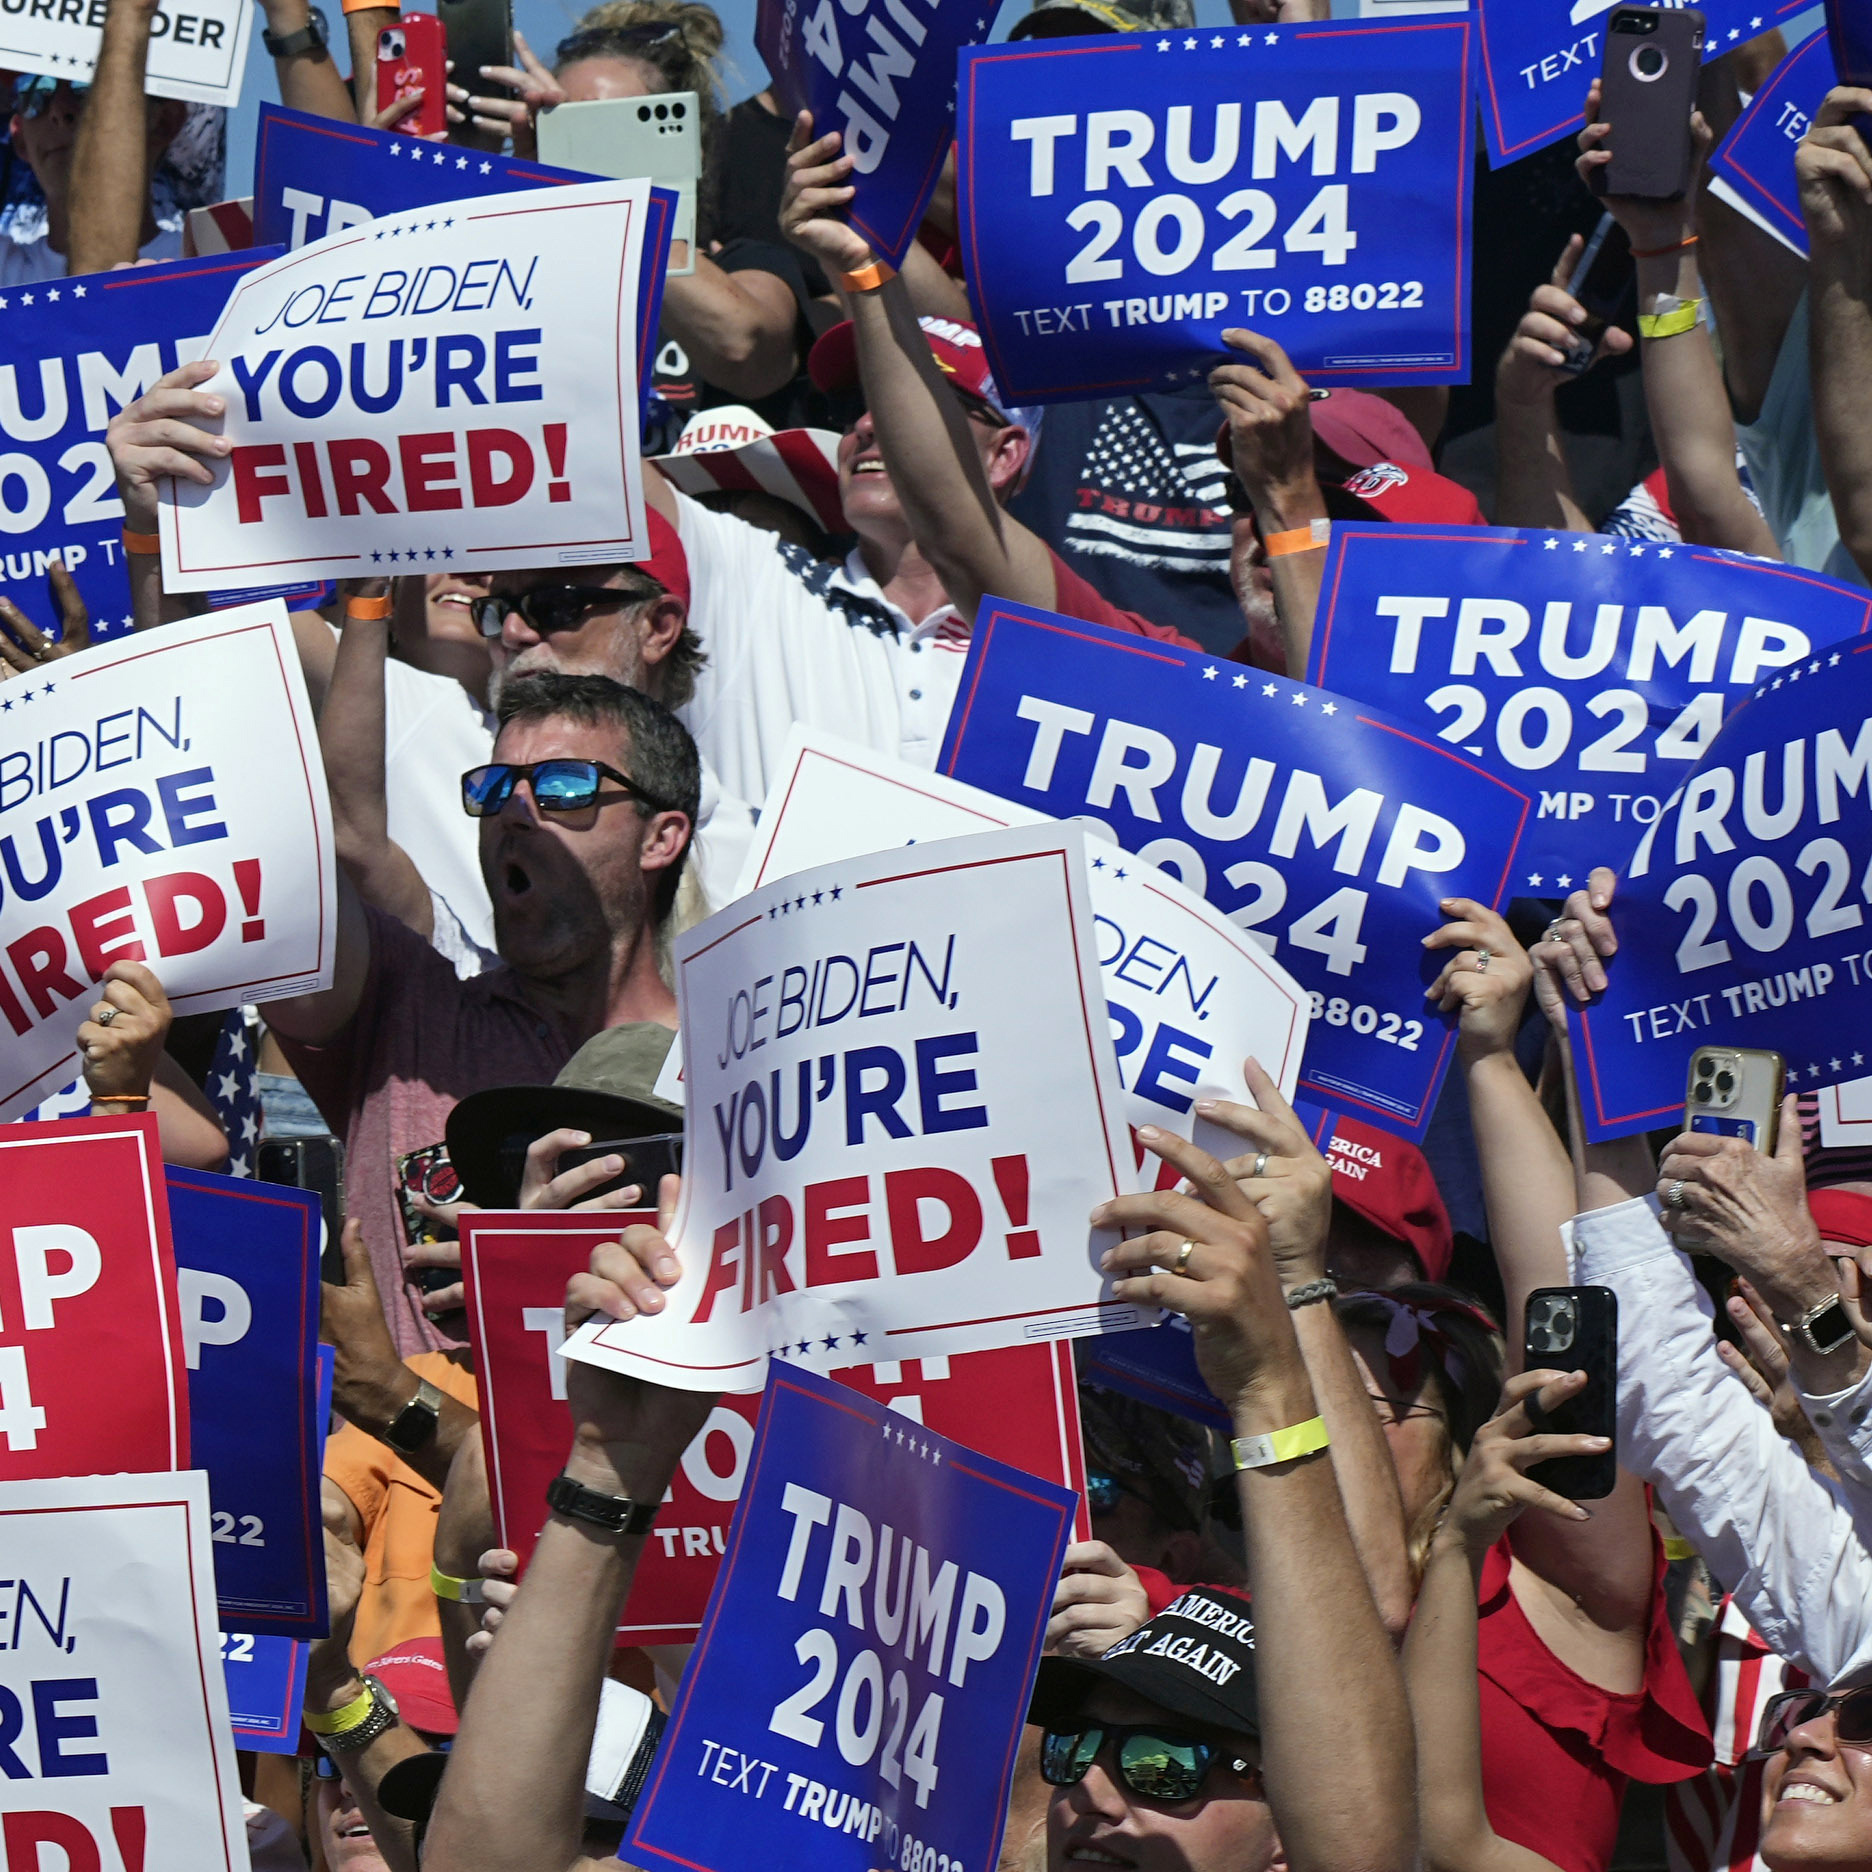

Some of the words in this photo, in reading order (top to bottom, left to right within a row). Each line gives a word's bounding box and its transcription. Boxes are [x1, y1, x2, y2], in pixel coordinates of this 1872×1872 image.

[1010, 90, 1423, 198] TRUMP
[1063, 183, 1358, 286] 2024
[254, 285, 356, 337] JOE
[364, 255, 540, 321] BIDEN,
[1014, 306, 1095, 338] TEXT
[1104, 290, 1230, 329] TRUMP
[1241, 287, 1292, 317] TO
[1303, 279, 1424, 313] 88022
[230, 329, 544, 423] YOU'RE
[230, 422, 576, 525] FIRED!
[1073, 487, 1225, 527] TRUMP
[1375, 594, 1813, 686] TRUMP
[1423, 684, 1726, 776] 2024
[1015, 693, 1467, 892] TRUMP
[1607, 793, 1661, 825] TO
[1661, 836, 1872, 975] 202
[715, 980, 772, 1071] JOE
[773, 933, 960, 1038] BIDEN,
[1623, 992, 1713, 1044] TEXT
[1721, 961, 1836, 1020] TRUMP
[713, 1030, 990, 1191] YOU'RE
[690, 1153, 1043, 1326] FIRED!
[779, 1481, 1008, 1690] TRUMP
[1143, 1631, 1242, 1686] AGAIN
[769, 1628, 939, 1810] 2024
[695, 1737, 771, 1799] TEXT
[782, 1771, 884, 1845] TRUMP
